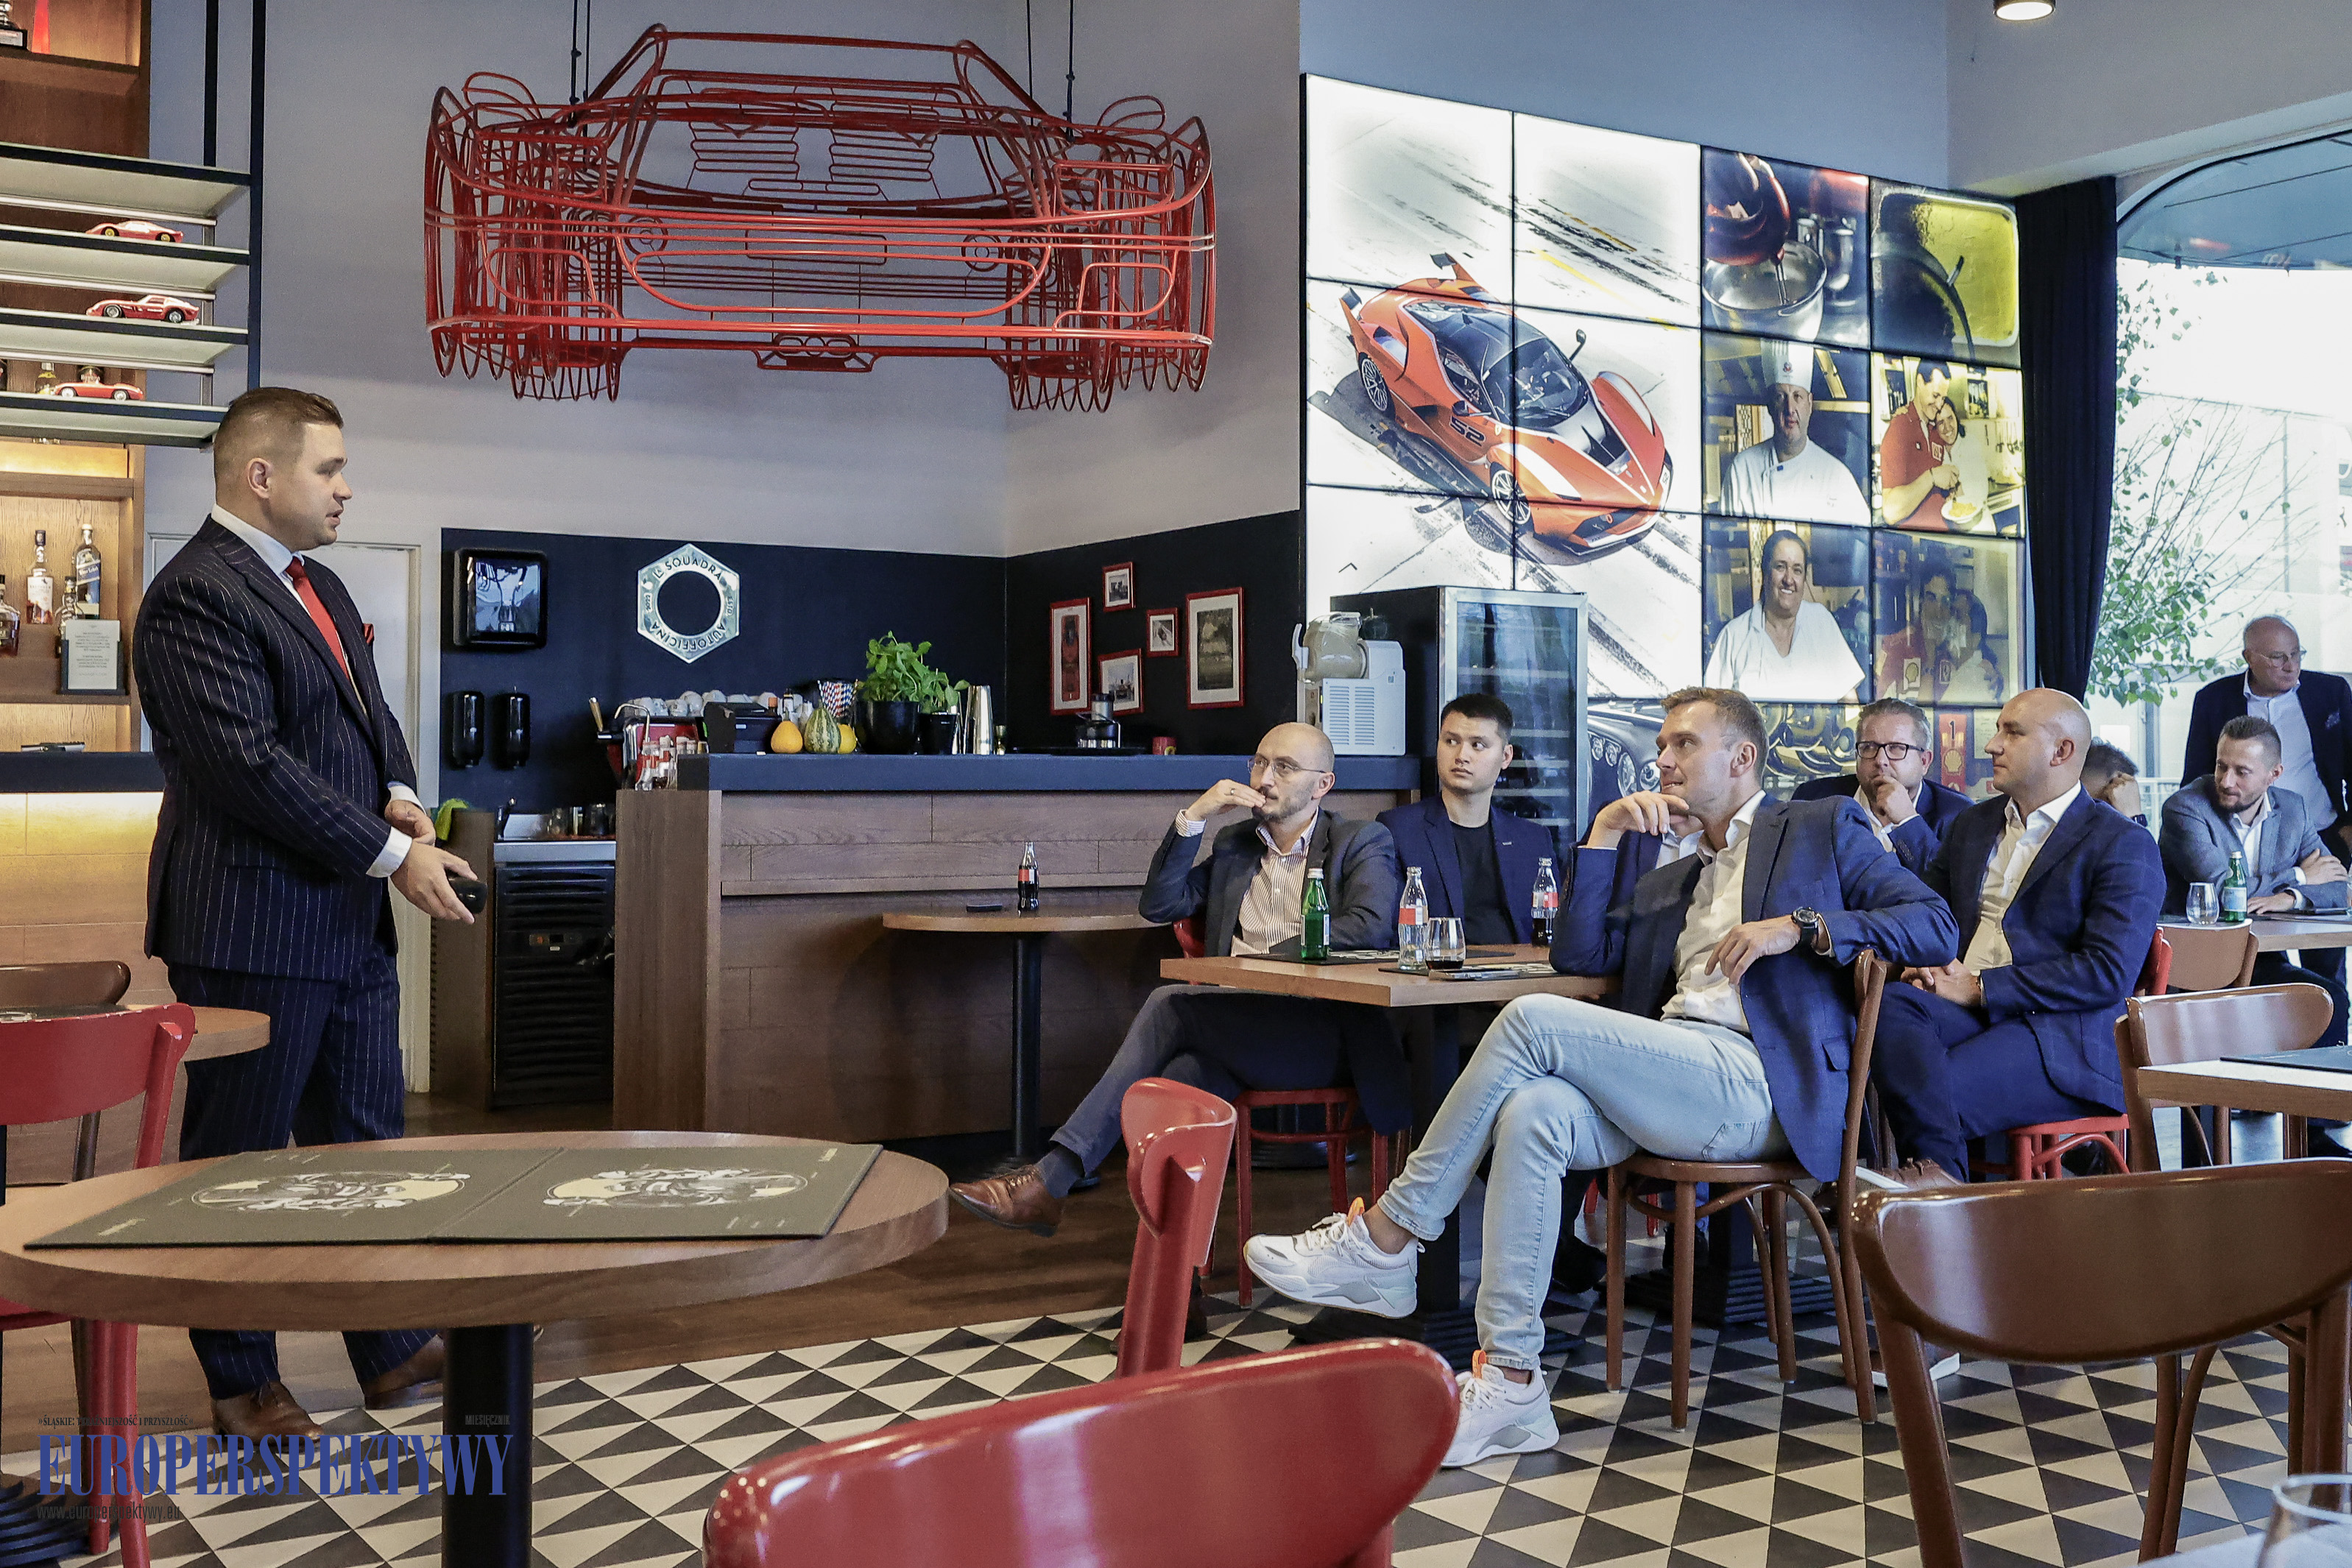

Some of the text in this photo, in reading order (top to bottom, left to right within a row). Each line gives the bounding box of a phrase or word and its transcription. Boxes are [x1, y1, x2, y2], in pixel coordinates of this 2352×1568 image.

[1449, 416, 1484, 446] 52
[665, 557, 722, 580] SQUADRA
[651, 621, 725, 650] AUTOFFICINA
